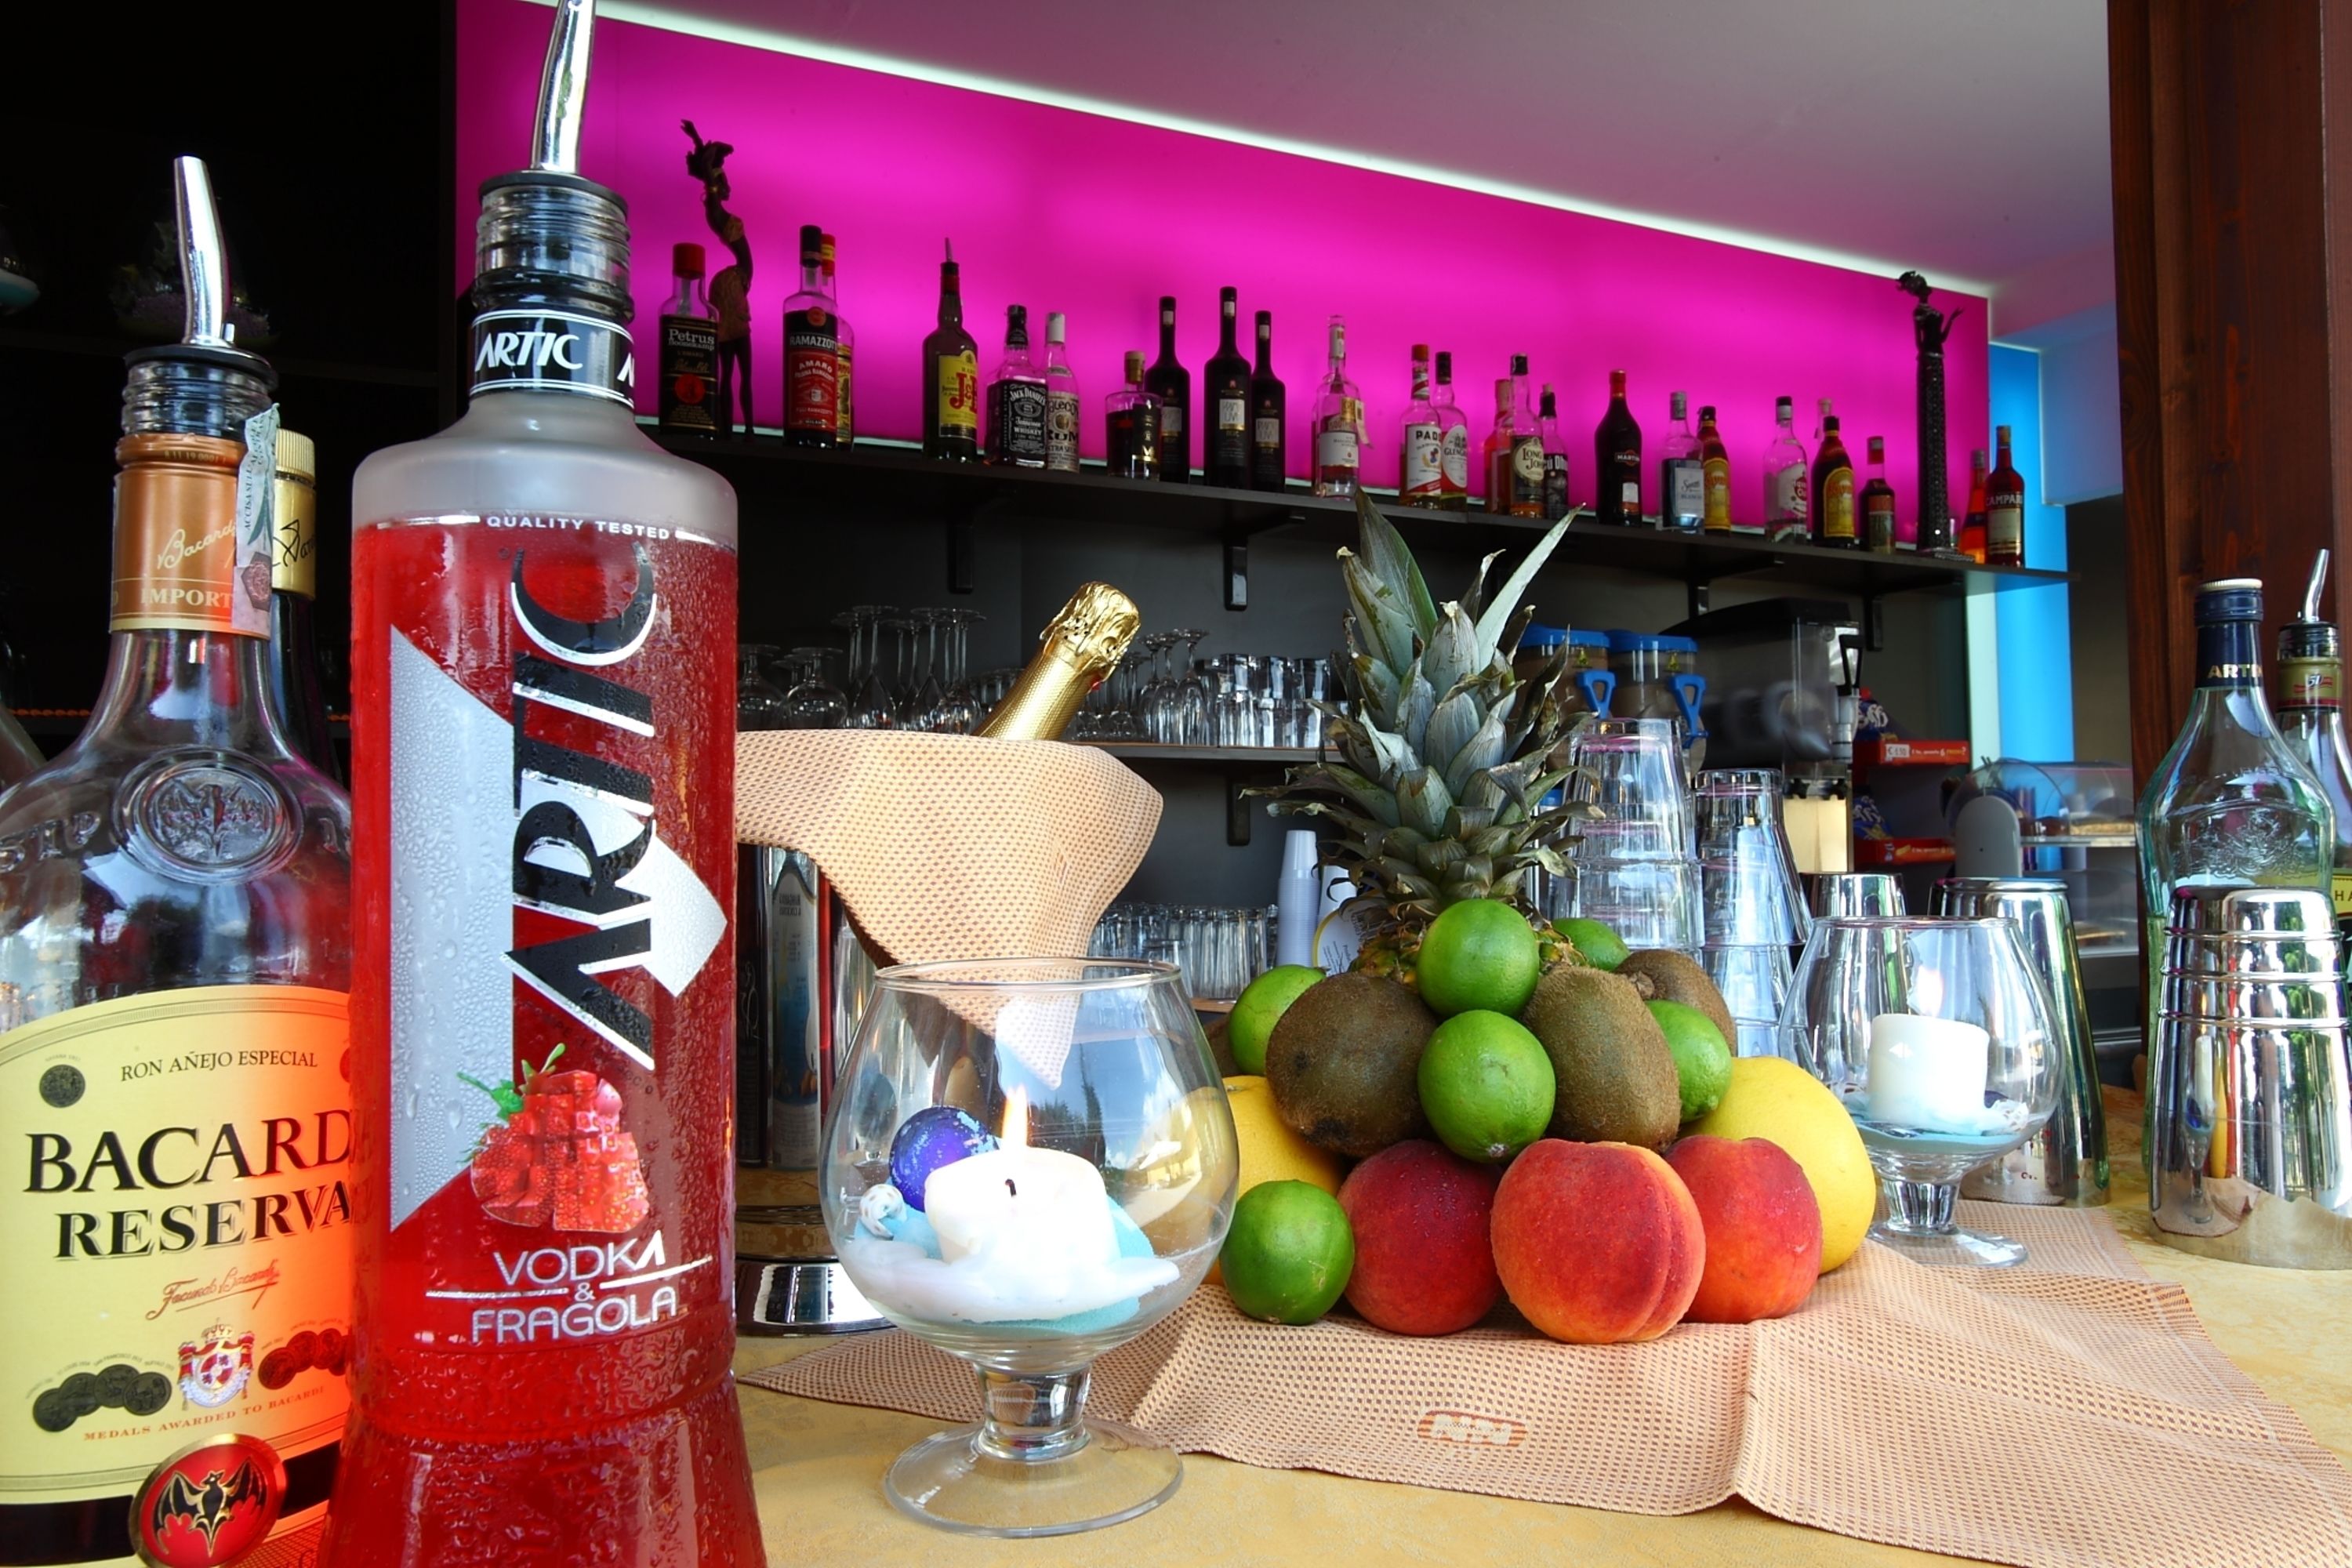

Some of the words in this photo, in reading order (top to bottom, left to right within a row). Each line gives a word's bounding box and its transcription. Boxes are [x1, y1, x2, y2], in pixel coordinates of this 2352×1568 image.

[668, 328, 715, 345] Petrus
[789, 335, 837, 351] RAMAZZOT
[475, 331, 584, 372] ARTIC
[799, 360, 833, 373] AMARO
[1009, 390, 1025, 401] JACK
[1014, 426, 1042, 436] WHISKEY
[1522, 448, 1543, 461] LONG
[1525, 459, 1544, 470] JO
[1986, 495, 2023, 506] CAMPAR
[244, 494, 252, 531] ACCISA
[487, 516, 584, 531] QUALITY
[595, 521, 670, 540] TESTED
[140, 587, 234, 608] IMPORT
[2307, 673, 2321, 688] 51
[499, 541, 655, 1072] ARTIC
[121, 1059, 162, 1082] RON
[169, 1051, 233, 1074] AÑEJO
[238, 1050, 318, 1068] ESPECIAL
[23, 1109, 350, 1193] BACARD
[54, 1180, 350, 1261] RESERVA
[493, 1229, 666, 1286] VODKA
[574, 1282, 595, 1302] &
[471, 1286, 677, 1344] FRAGOLA
[83, 1425, 151, 1441] MEDALS
[158, 1410, 236, 1432] AWARDED
[242, 1403, 263, 1416] TO
[267, 1387, 325, 1409] BACARDI
